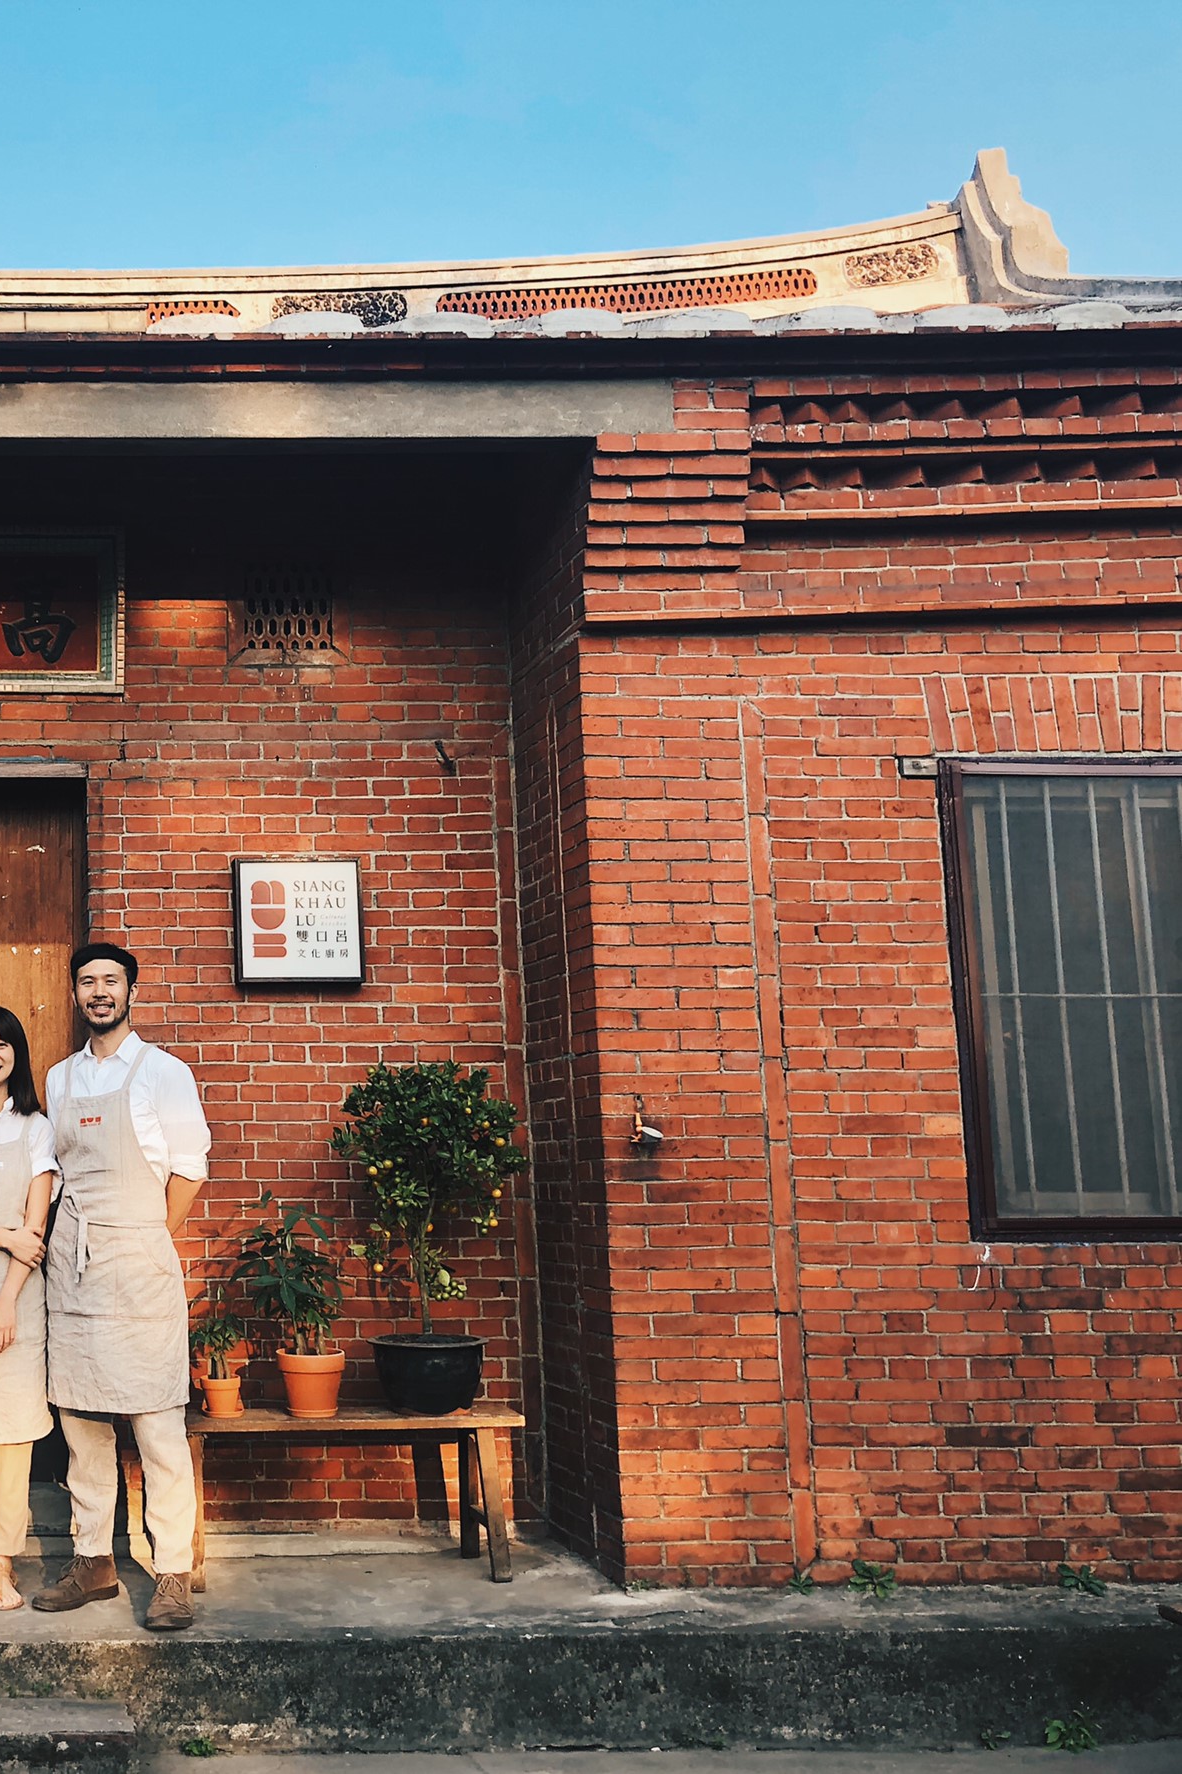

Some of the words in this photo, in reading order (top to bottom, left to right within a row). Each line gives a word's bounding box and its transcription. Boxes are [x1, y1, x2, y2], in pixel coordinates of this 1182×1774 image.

[293, 880, 346, 893] SIANG
[294, 894, 346, 909] KHÁU
[297, 948, 349, 959] 文化廚房
